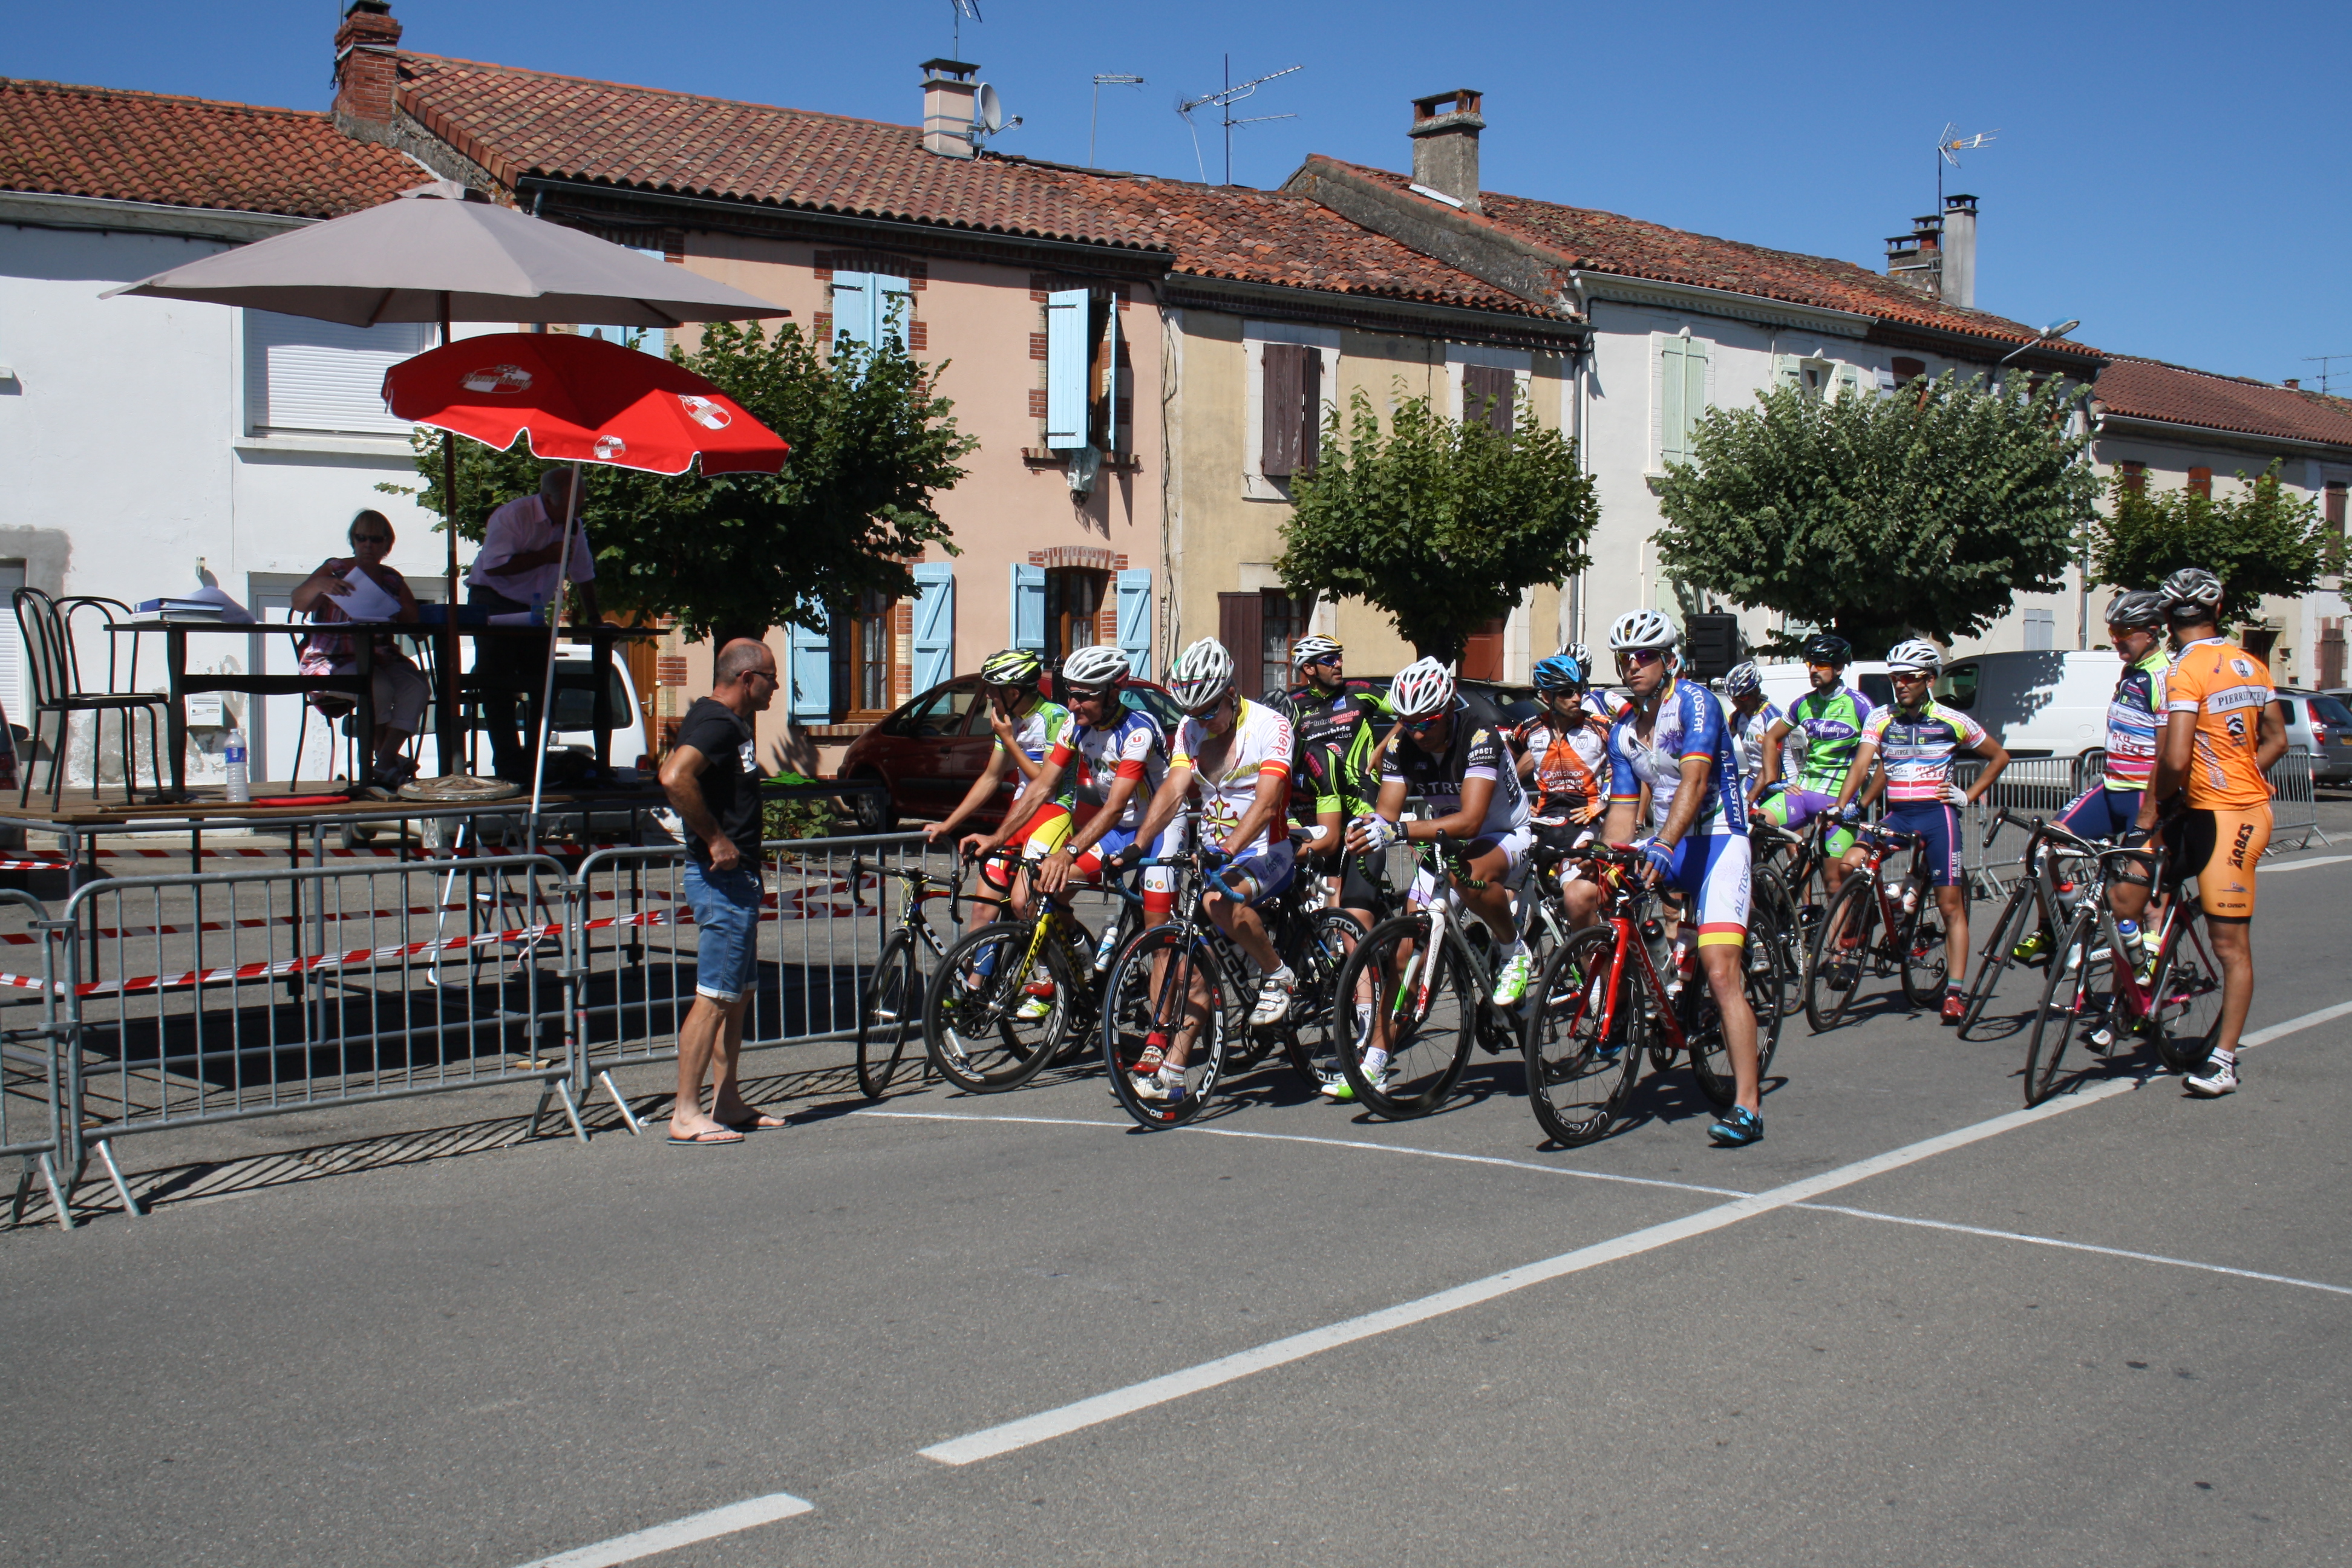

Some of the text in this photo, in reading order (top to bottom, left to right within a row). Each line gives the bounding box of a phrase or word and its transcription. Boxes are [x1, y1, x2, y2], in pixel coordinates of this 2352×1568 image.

[1726, 773, 1742, 825] TOSTAT
[2231, 823, 2254, 871] ARBES
[1734, 898, 1745, 918] AL
[1209, 923, 1255, 1004] FOCUS
[1428, 938, 1439, 977] COLNAGO
[1112, 950, 1142, 1045] EASTON
[1628, 940, 1673, 1029] PINARELLO
[1195, 1011, 1224, 1103] EASTON
[1149, 1108, 1175, 1120] EC90
